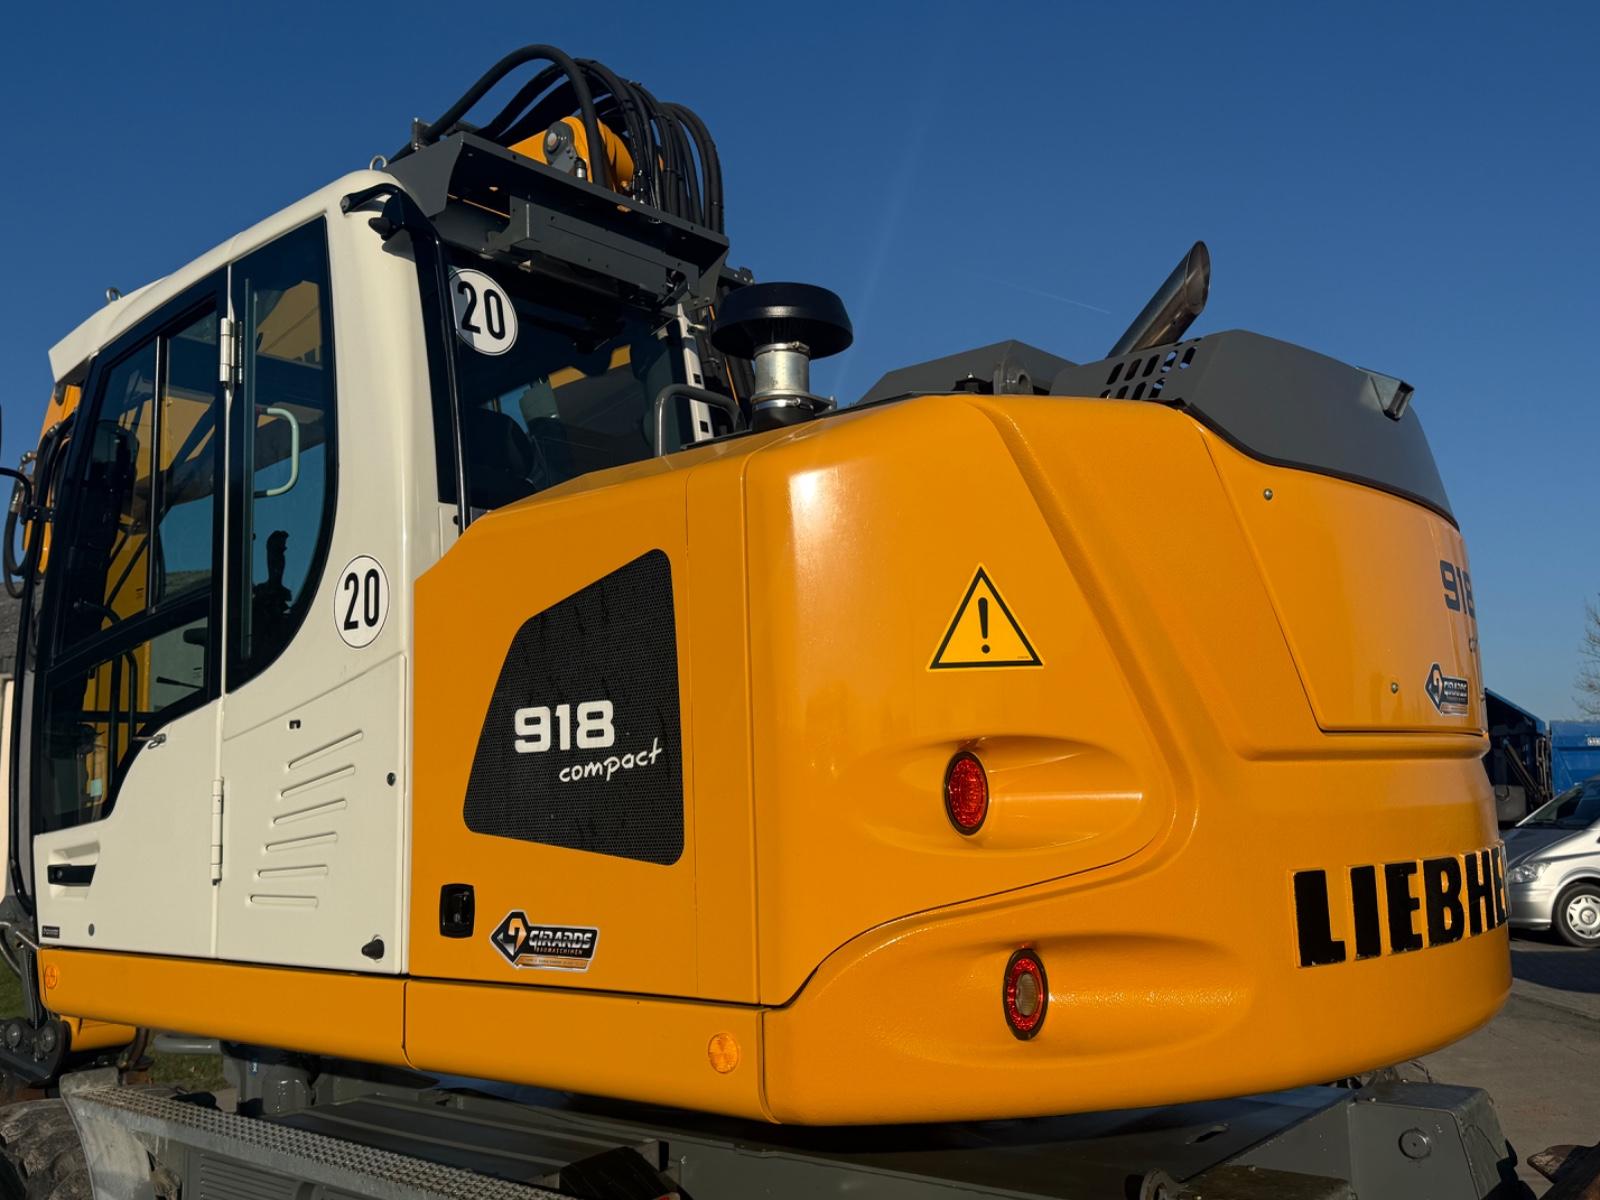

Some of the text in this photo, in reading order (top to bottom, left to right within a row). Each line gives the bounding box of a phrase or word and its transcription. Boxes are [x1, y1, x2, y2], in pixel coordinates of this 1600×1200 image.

[458, 281, 505, 340] 20
[344, 568, 380, 631] 20
[515, 700, 615, 753] 918
[559, 737, 662, 782] compact
[529, 930, 592, 950] GIRARDS
